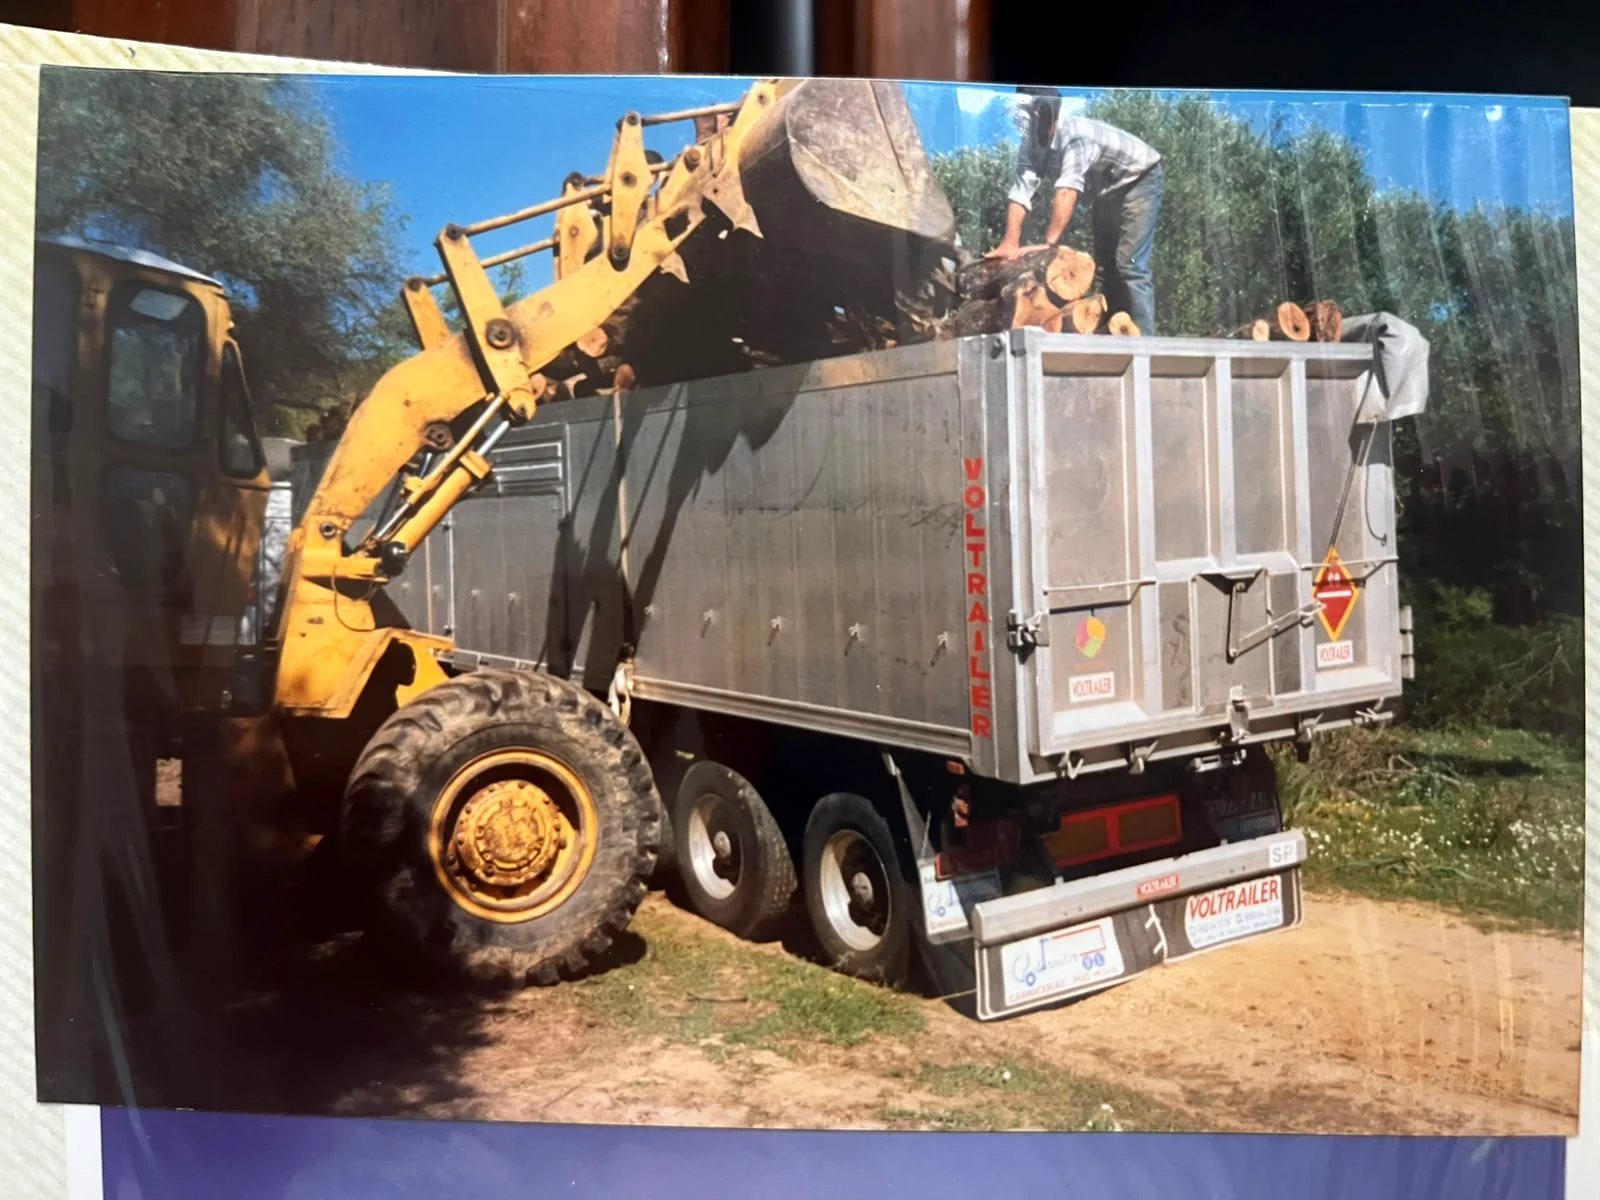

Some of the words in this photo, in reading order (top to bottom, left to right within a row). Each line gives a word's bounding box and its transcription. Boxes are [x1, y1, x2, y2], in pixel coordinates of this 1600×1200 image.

[963, 458, 992, 738] VOLTRAILER
[1272, 844, 1293, 863] SP
[1189, 879, 1279, 919] VOLTRAILER
